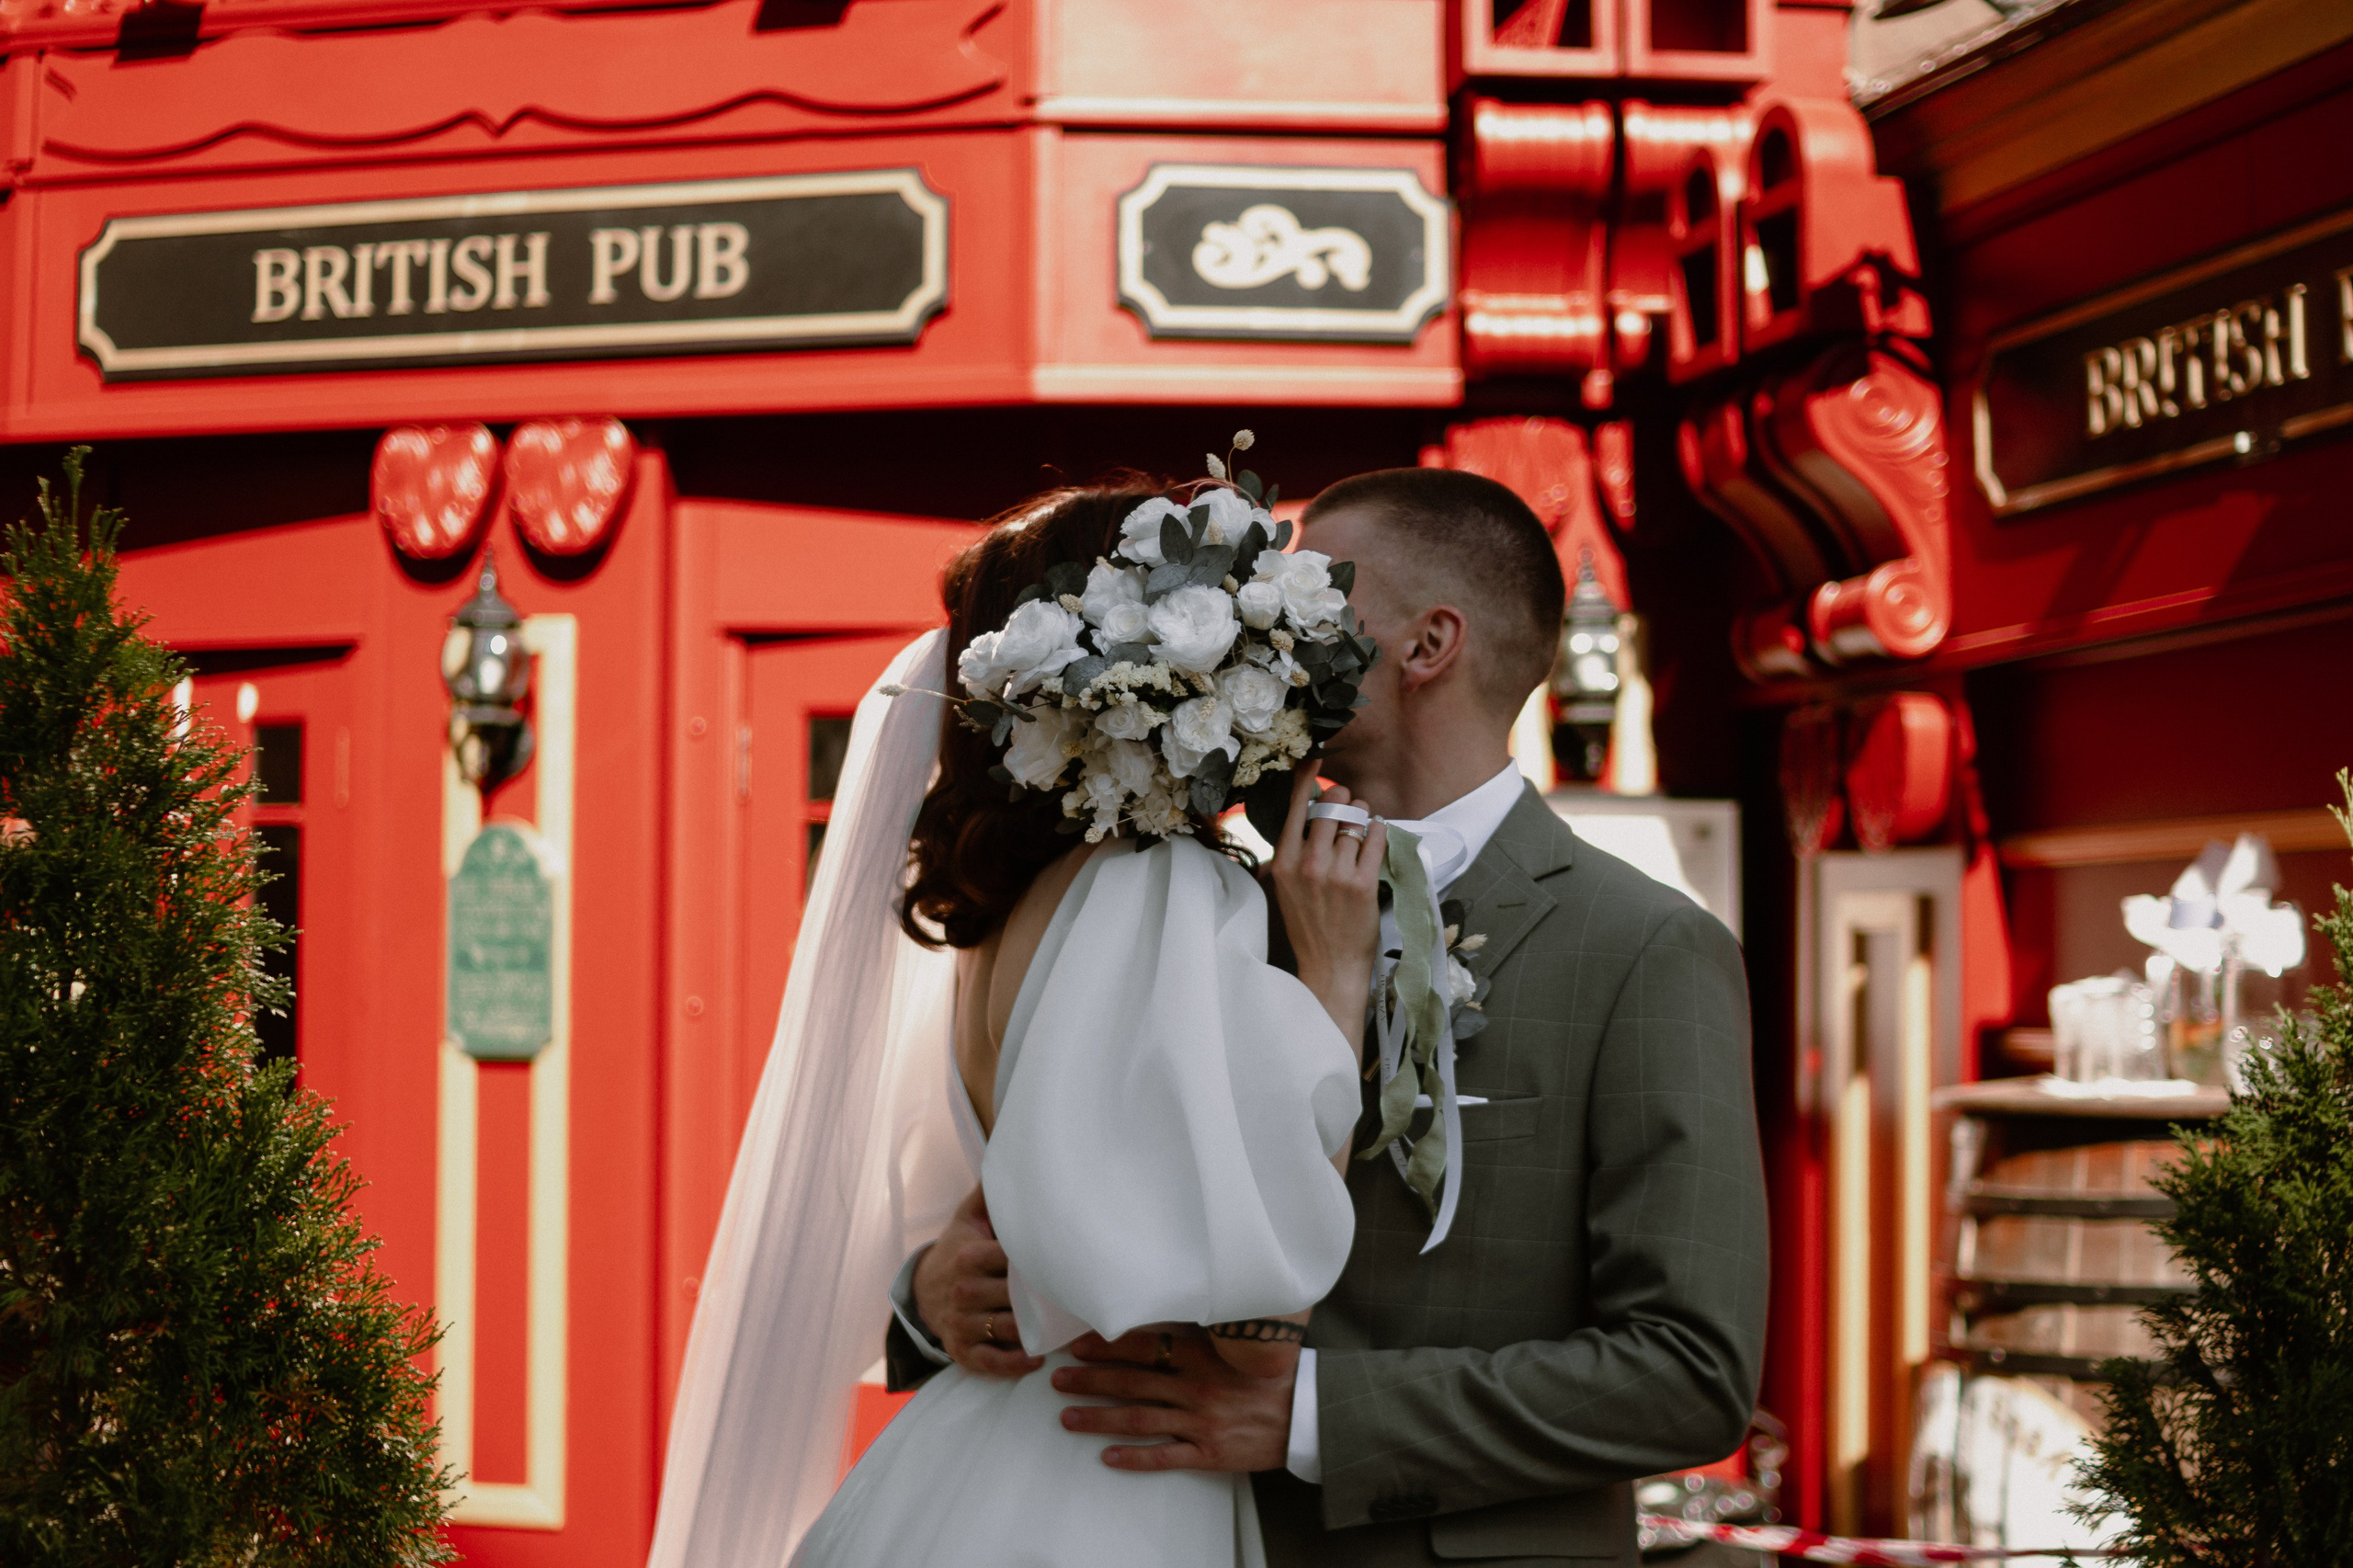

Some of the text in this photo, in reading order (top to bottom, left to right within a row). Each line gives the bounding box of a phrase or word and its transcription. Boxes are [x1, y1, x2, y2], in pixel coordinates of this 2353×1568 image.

[251, 222, 751, 324] BRITISH PUB
[2084, 282, 2311, 437] BRITISH
